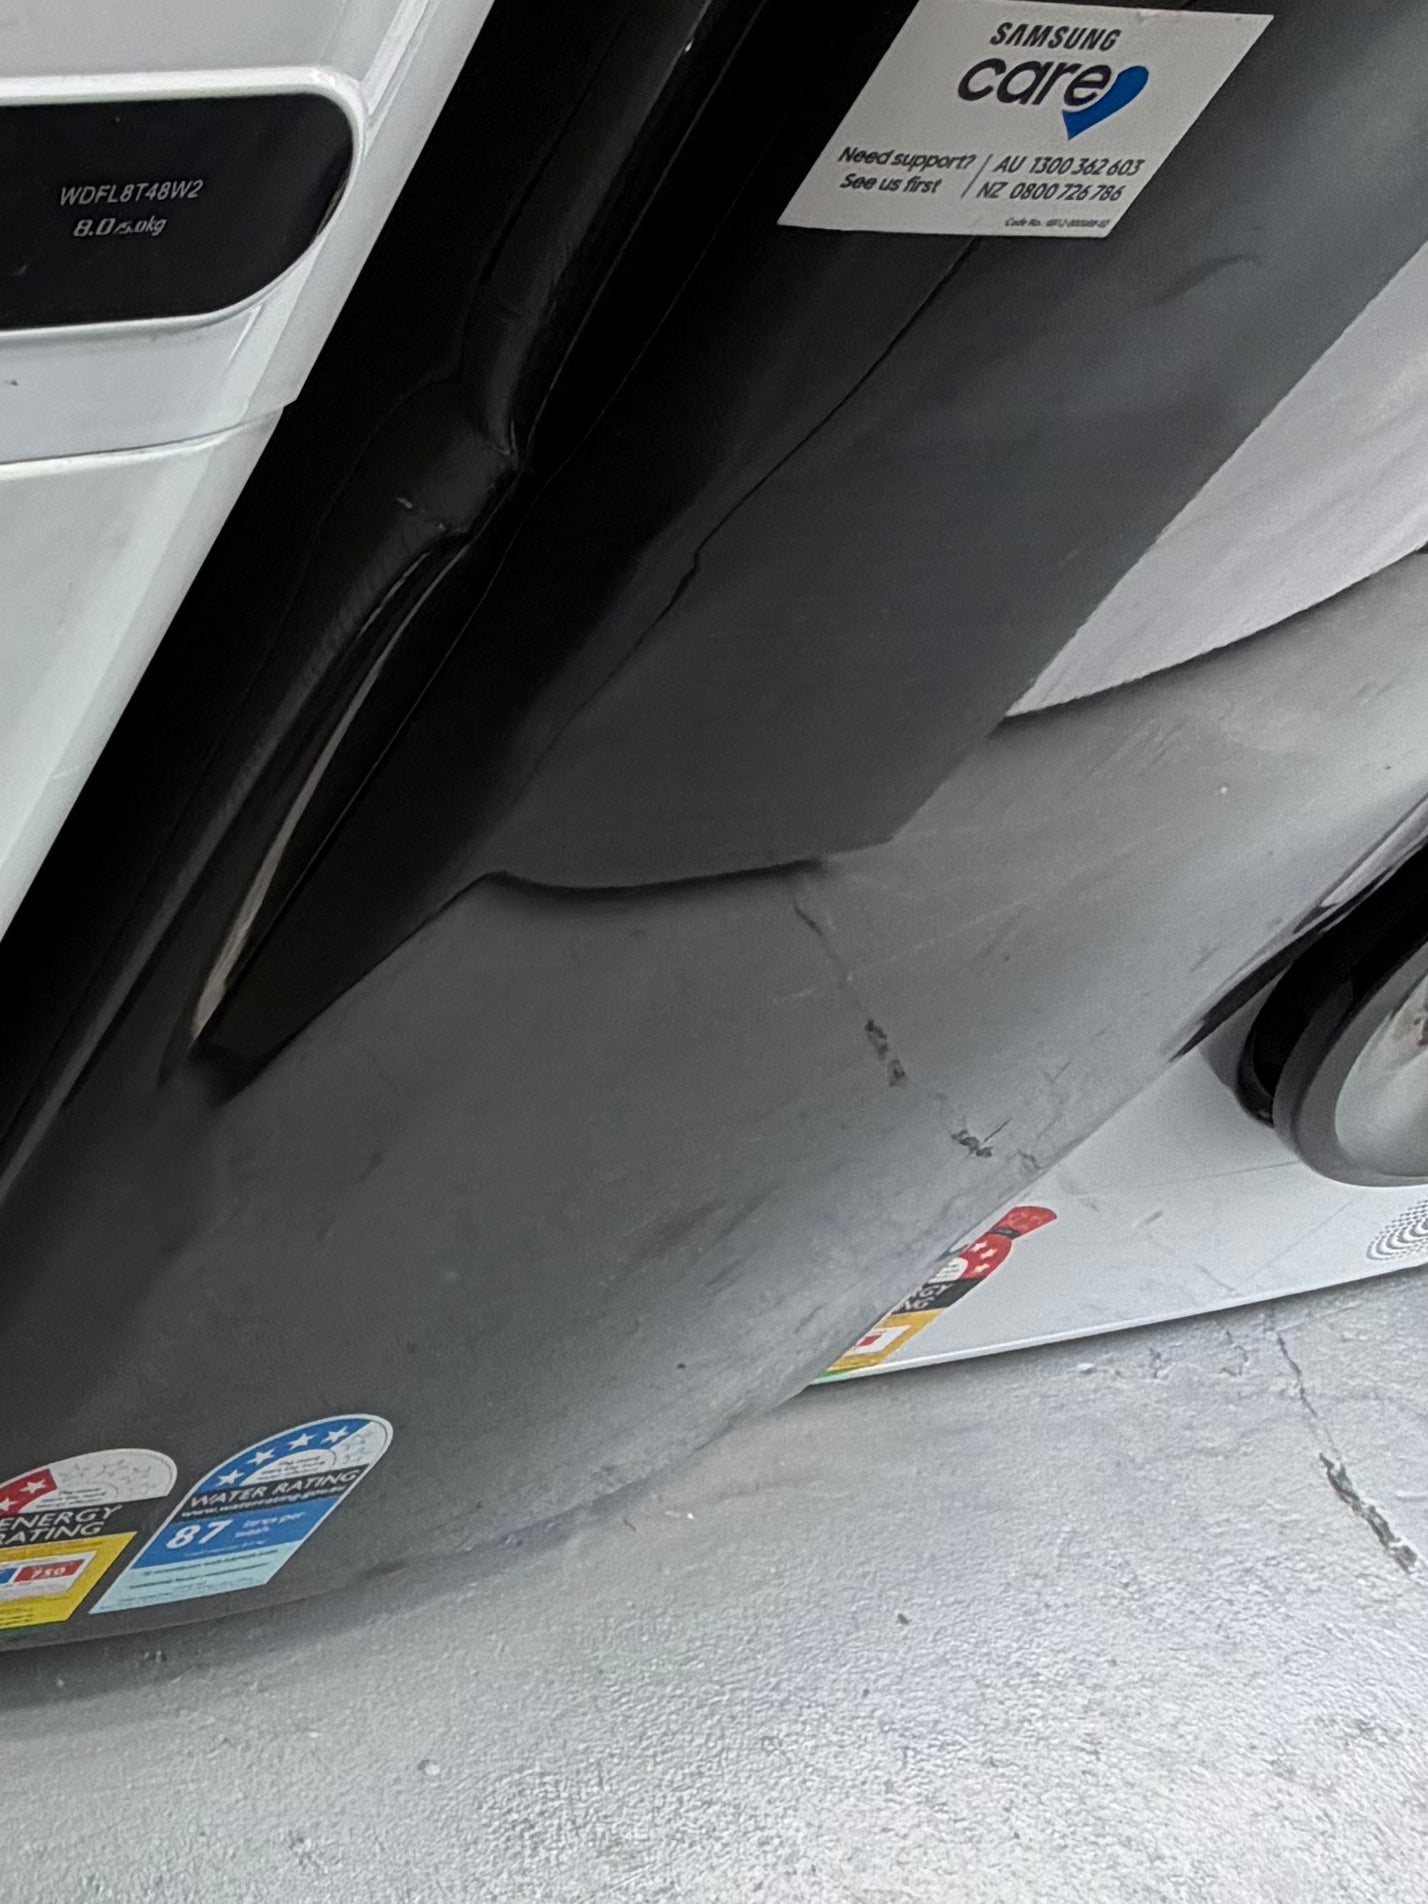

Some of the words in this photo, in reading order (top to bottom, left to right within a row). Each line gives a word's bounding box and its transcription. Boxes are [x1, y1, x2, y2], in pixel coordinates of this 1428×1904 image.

[990, 22, 1121, 52] SAMSUNG
[957, 57, 1112, 107] care
[838, 146, 893, 165] Need
[892, 152, 977, 173] support?
[993, 156, 1028, 174] AU
[1028, 156, 1072, 175] 1300
[1070, 158, 1109, 176] 362
[1106, 159, 1147, 177] 603
[59, 179, 204, 207] WDFL8T48W2
[840, 172, 876, 190] See
[879, 177, 904, 192] us
[902, 175, 942, 194] first
[976, 181, 1009, 199] NZ
[1008, 182, 1057, 201] 0800
[1056, 183, 1092, 201] 726
[1089, 184, 1127, 202] 786
[191, 1486, 266, 1508] WATER
[271, 1469, 361, 1497] RATING
[165, 1519, 235, 1550] 87
